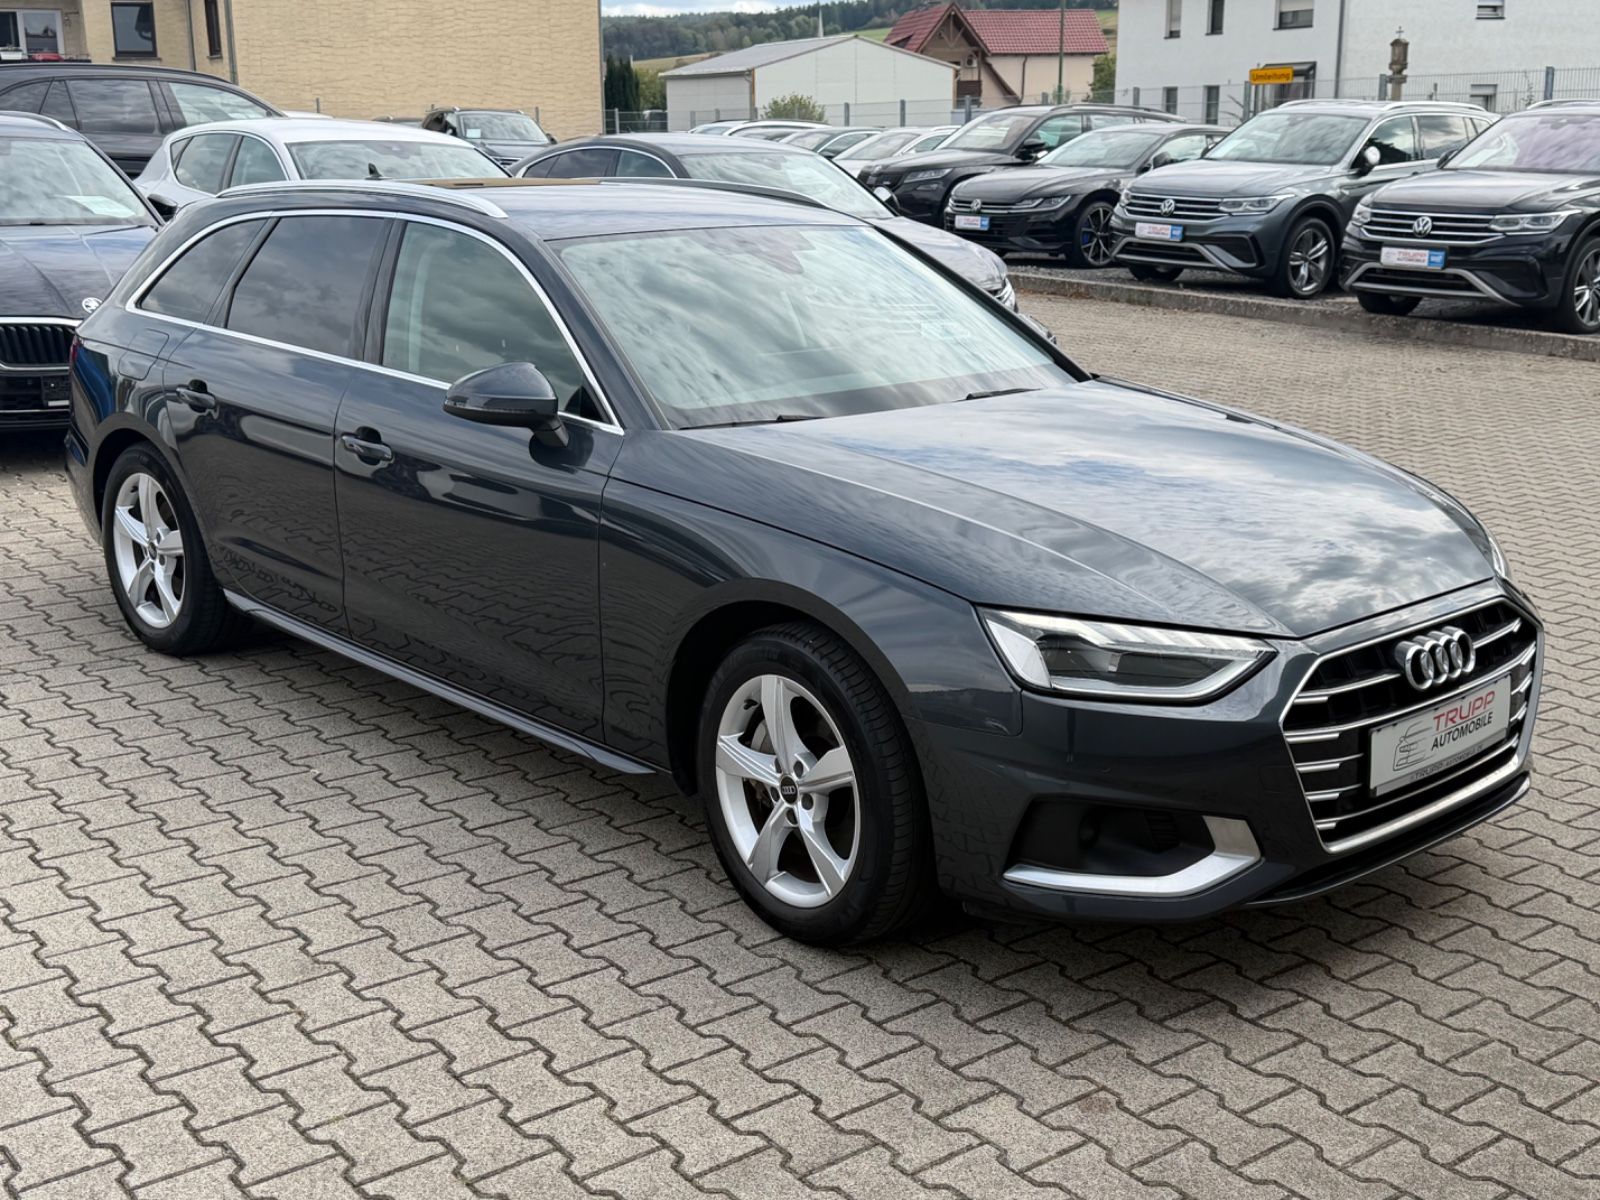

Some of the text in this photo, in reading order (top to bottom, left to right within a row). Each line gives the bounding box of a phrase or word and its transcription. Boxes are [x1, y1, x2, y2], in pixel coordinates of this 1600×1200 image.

[1251, 71, 1291, 82] Umleitung
[1431, 711, 1493, 751] AUTOMOBILE
[1433, 691, 1495, 732] TRUPP
